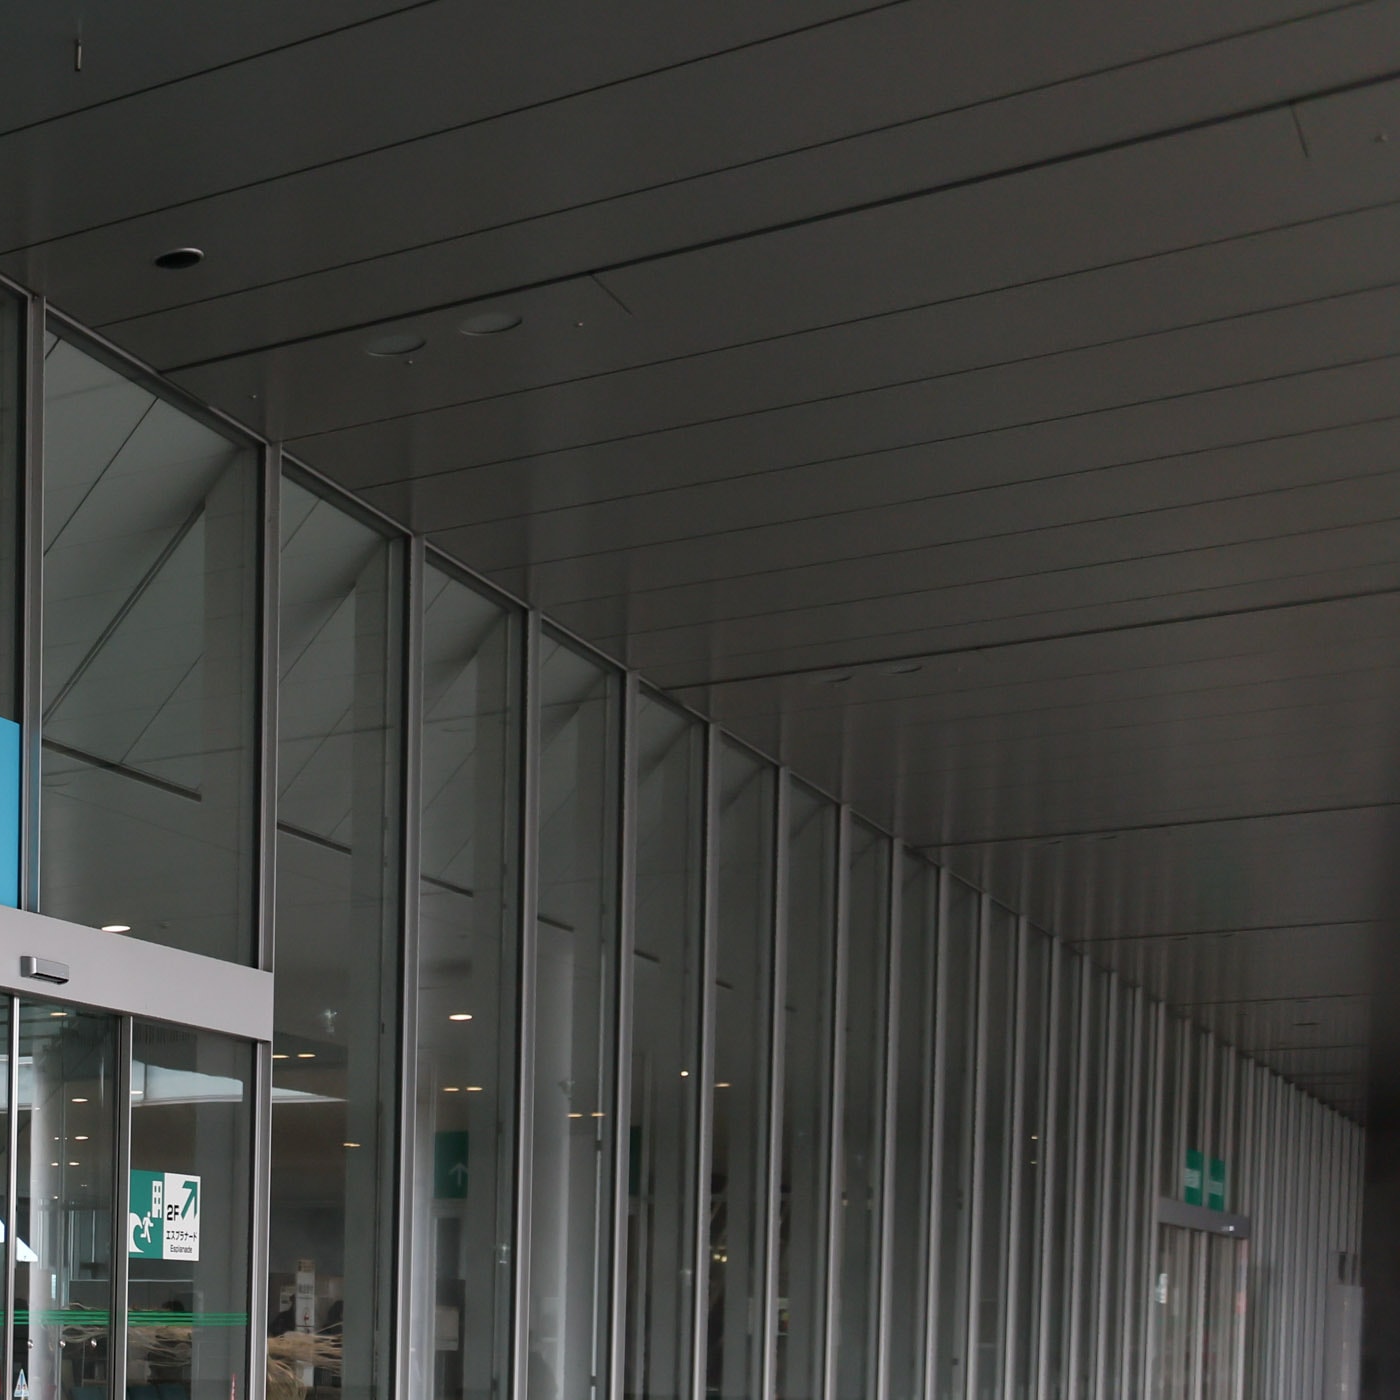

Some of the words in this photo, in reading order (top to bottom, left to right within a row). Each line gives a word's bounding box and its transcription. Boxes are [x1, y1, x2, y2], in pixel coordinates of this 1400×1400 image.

[166, 1203, 180, 1221] 2F
[166, 1230, 198, 1242] エスプラナード
[170, 1244, 193, 1254] Esplanade
